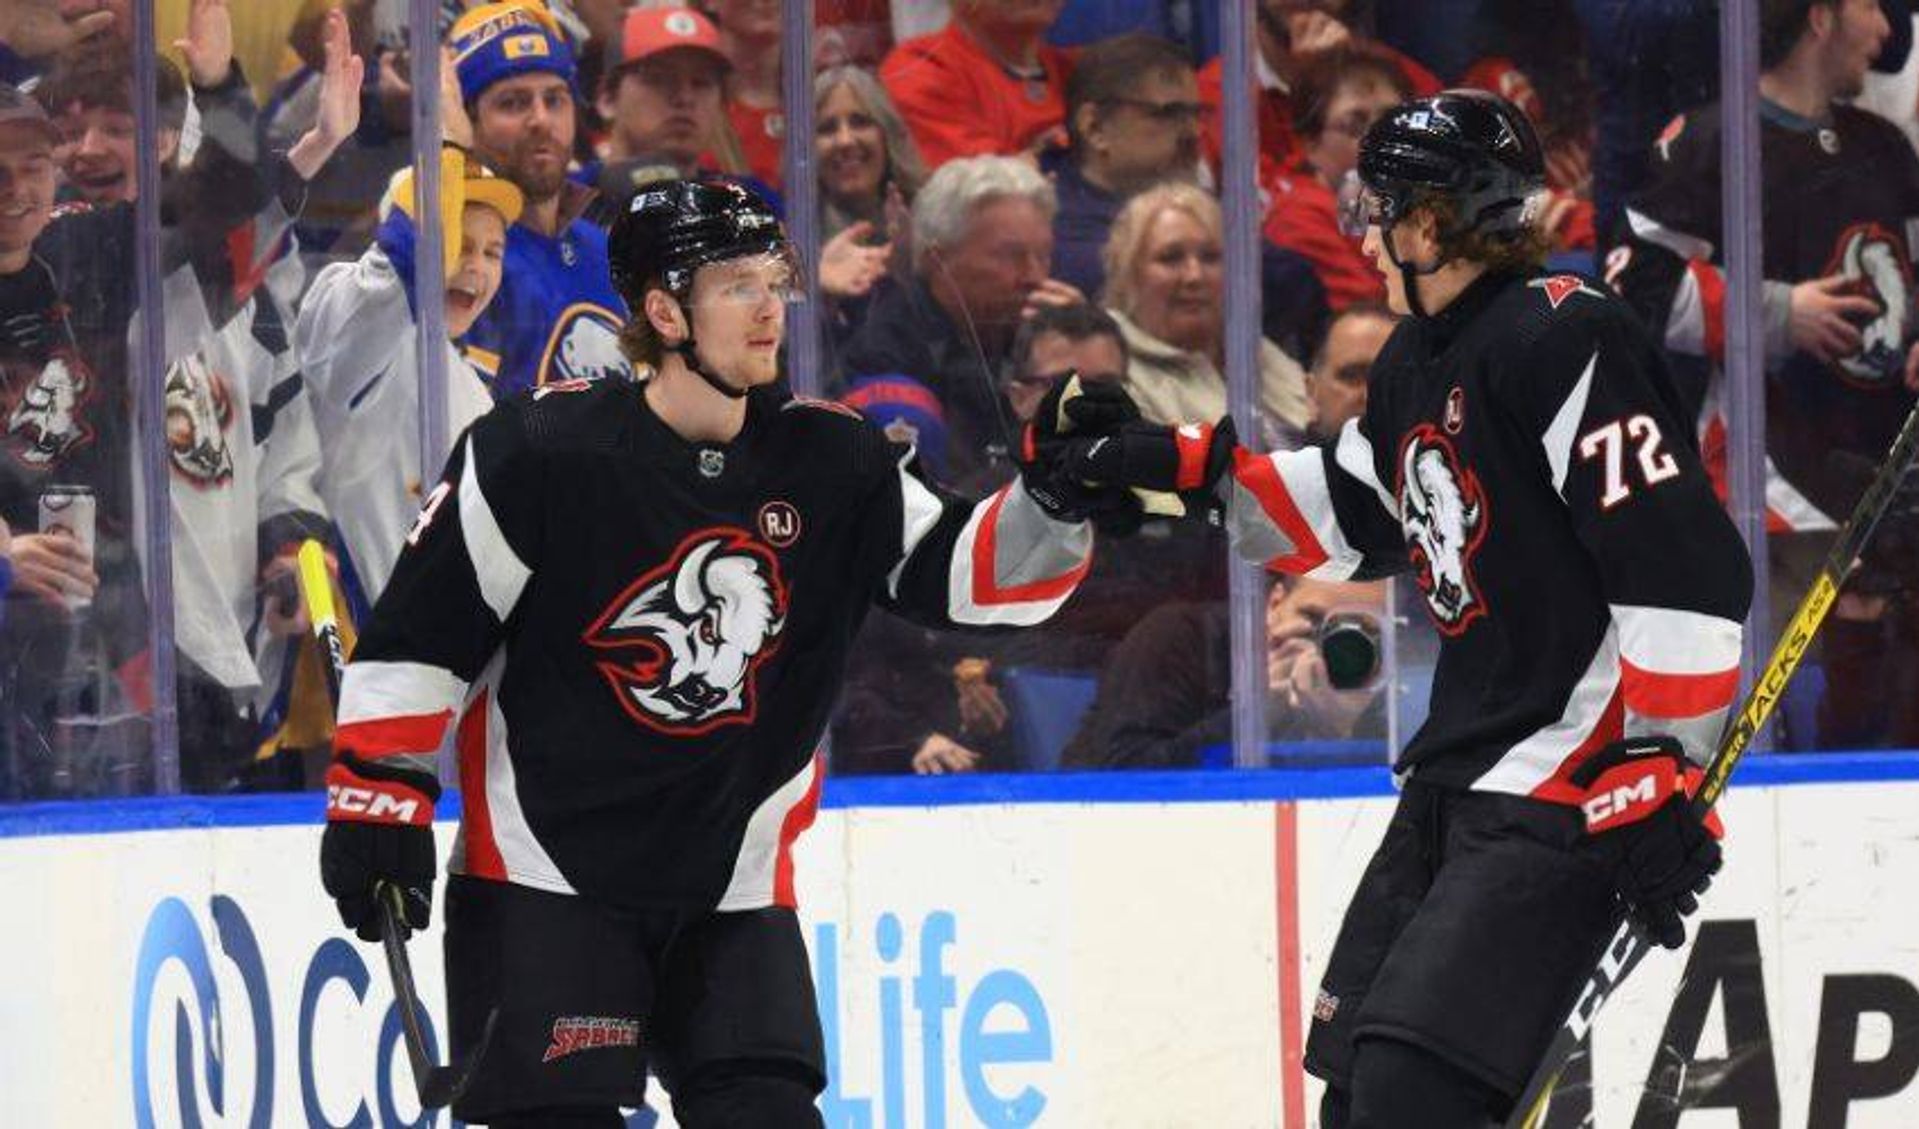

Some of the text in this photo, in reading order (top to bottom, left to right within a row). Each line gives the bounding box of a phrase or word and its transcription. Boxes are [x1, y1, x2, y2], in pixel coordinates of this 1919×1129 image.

[1578, 413, 1680, 508] 72
[765, 510, 793, 537] RJ
[1581, 773, 1657, 825] CM
[815, 909, 1053, 1129] Life
[1564, 918, 1638, 1043] CC
